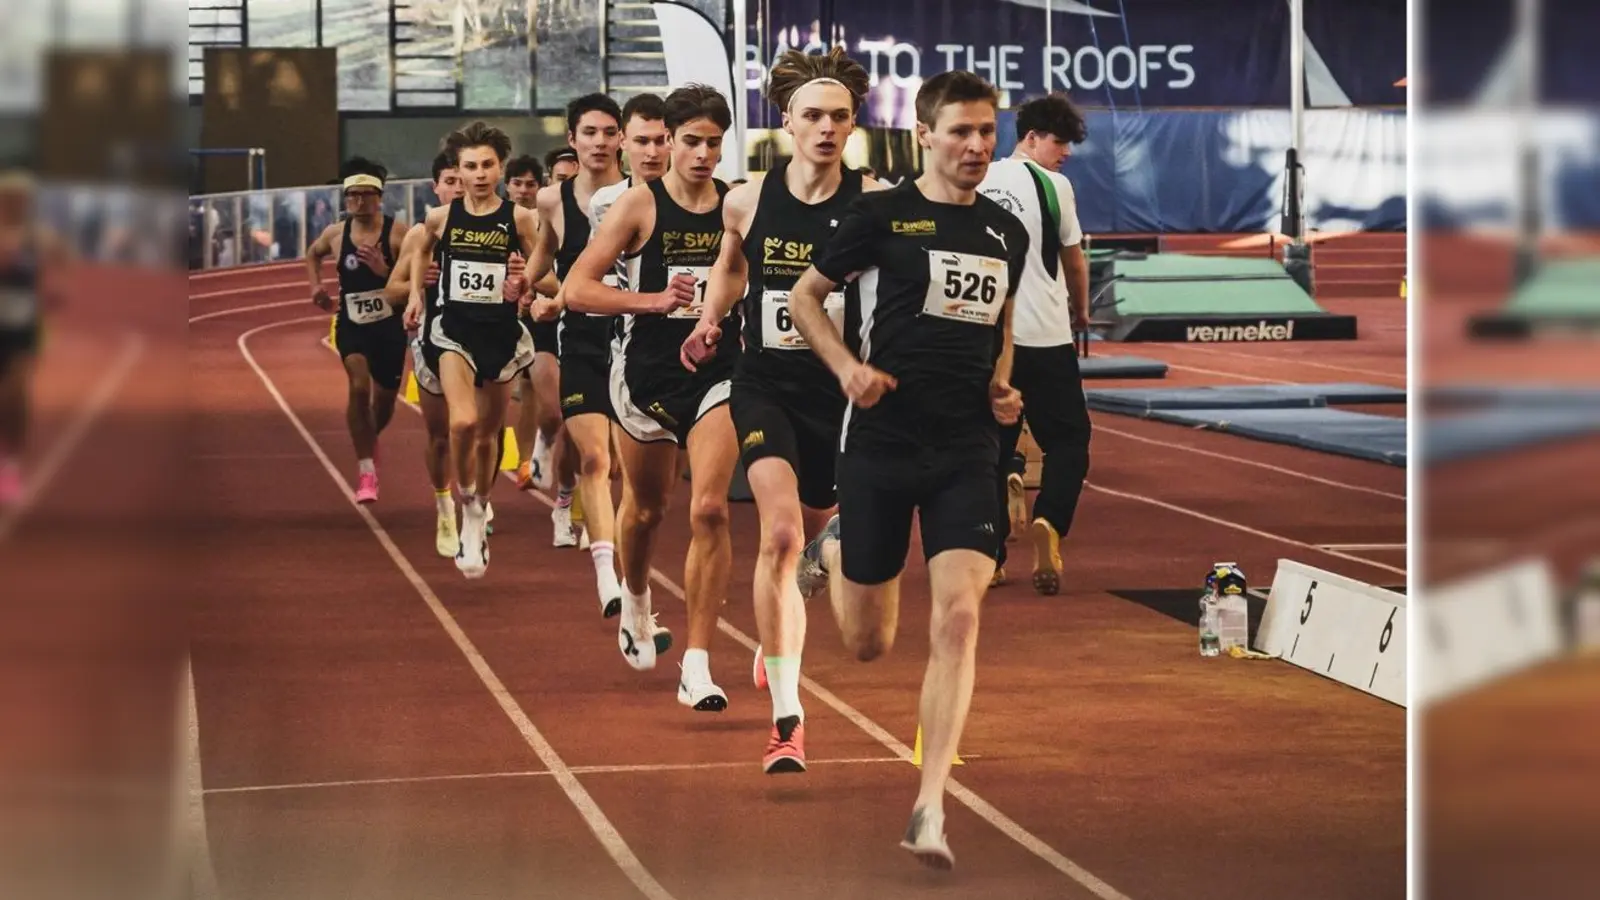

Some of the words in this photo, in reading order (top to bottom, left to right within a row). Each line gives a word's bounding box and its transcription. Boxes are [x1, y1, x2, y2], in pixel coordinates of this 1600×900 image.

[859, 41, 922, 89] TO
[936, 44, 1024, 90] THE
[1043, 44, 1196, 90] ROOFS
[459, 272, 495, 292] 634
[944, 269, 997, 305] 526
[354, 298, 383, 314] 750
[1186, 319, 1295, 342] vennekel
[1300, 581, 1318, 626] 5
[1379, 606, 1398, 654] 6
